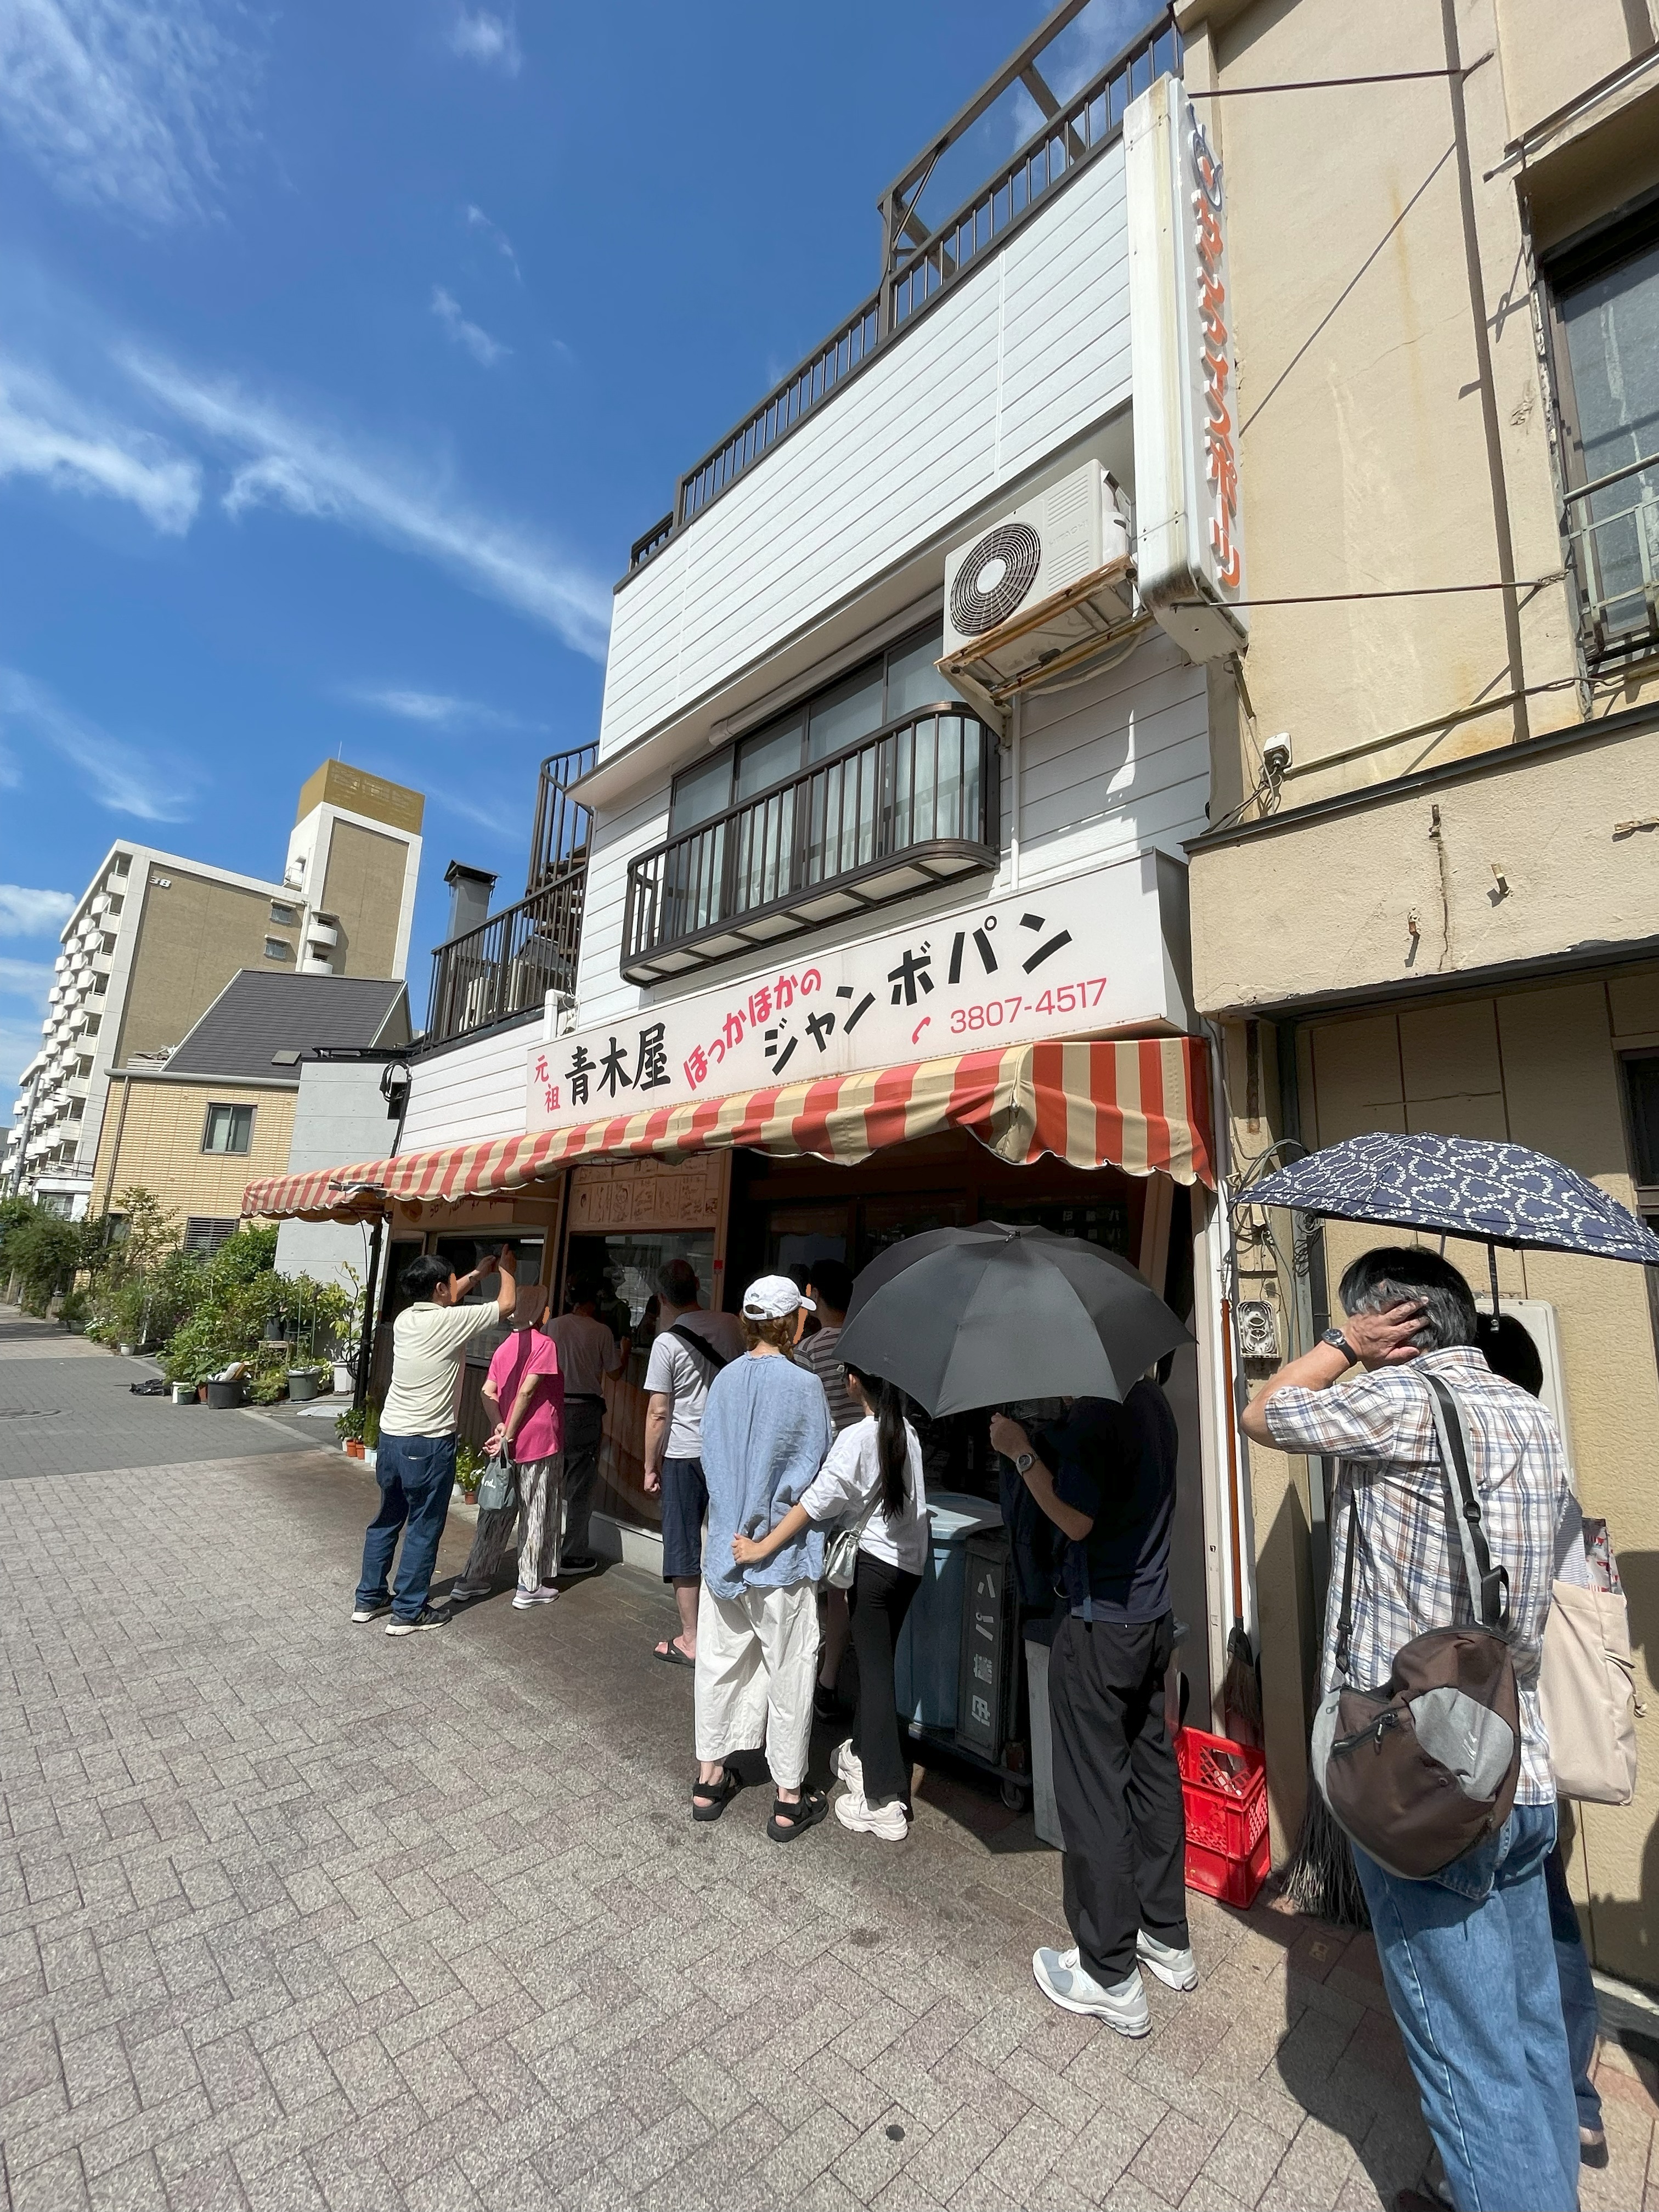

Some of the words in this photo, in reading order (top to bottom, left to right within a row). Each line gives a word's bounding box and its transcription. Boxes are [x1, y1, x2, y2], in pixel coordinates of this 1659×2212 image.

[149, 876, 171, 888] 38
[683, 968, 822, 1091] ほっかほかの
[764, 913, 1073, 1076] ジャンボパン
[951, 977, 1107, 1034] 3807-4517
[534, 1054, 561, 1114] 元祖
[565, 1022, 671, 1106] 青木屋
